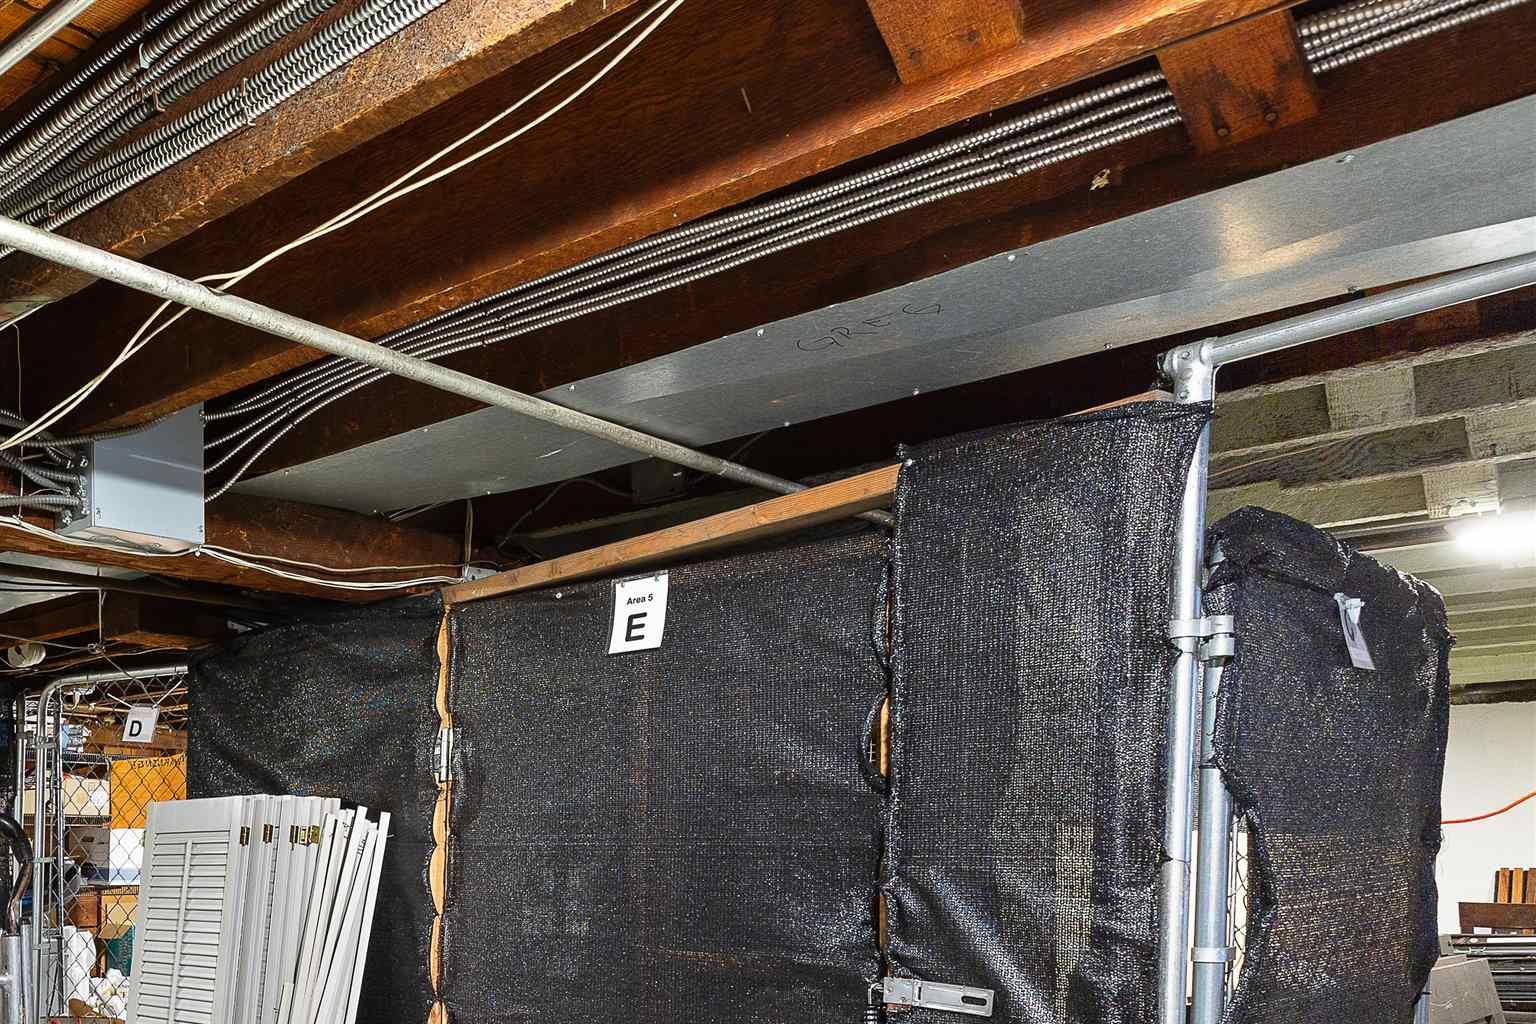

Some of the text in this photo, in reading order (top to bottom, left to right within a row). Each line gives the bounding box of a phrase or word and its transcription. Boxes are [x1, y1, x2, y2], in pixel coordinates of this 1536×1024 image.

[797, 303, 941, 351] GREG
[626, 593, 654, 606] Area 5
[625, 611, 647, 642] E
[128, 720, 143, 737] D
